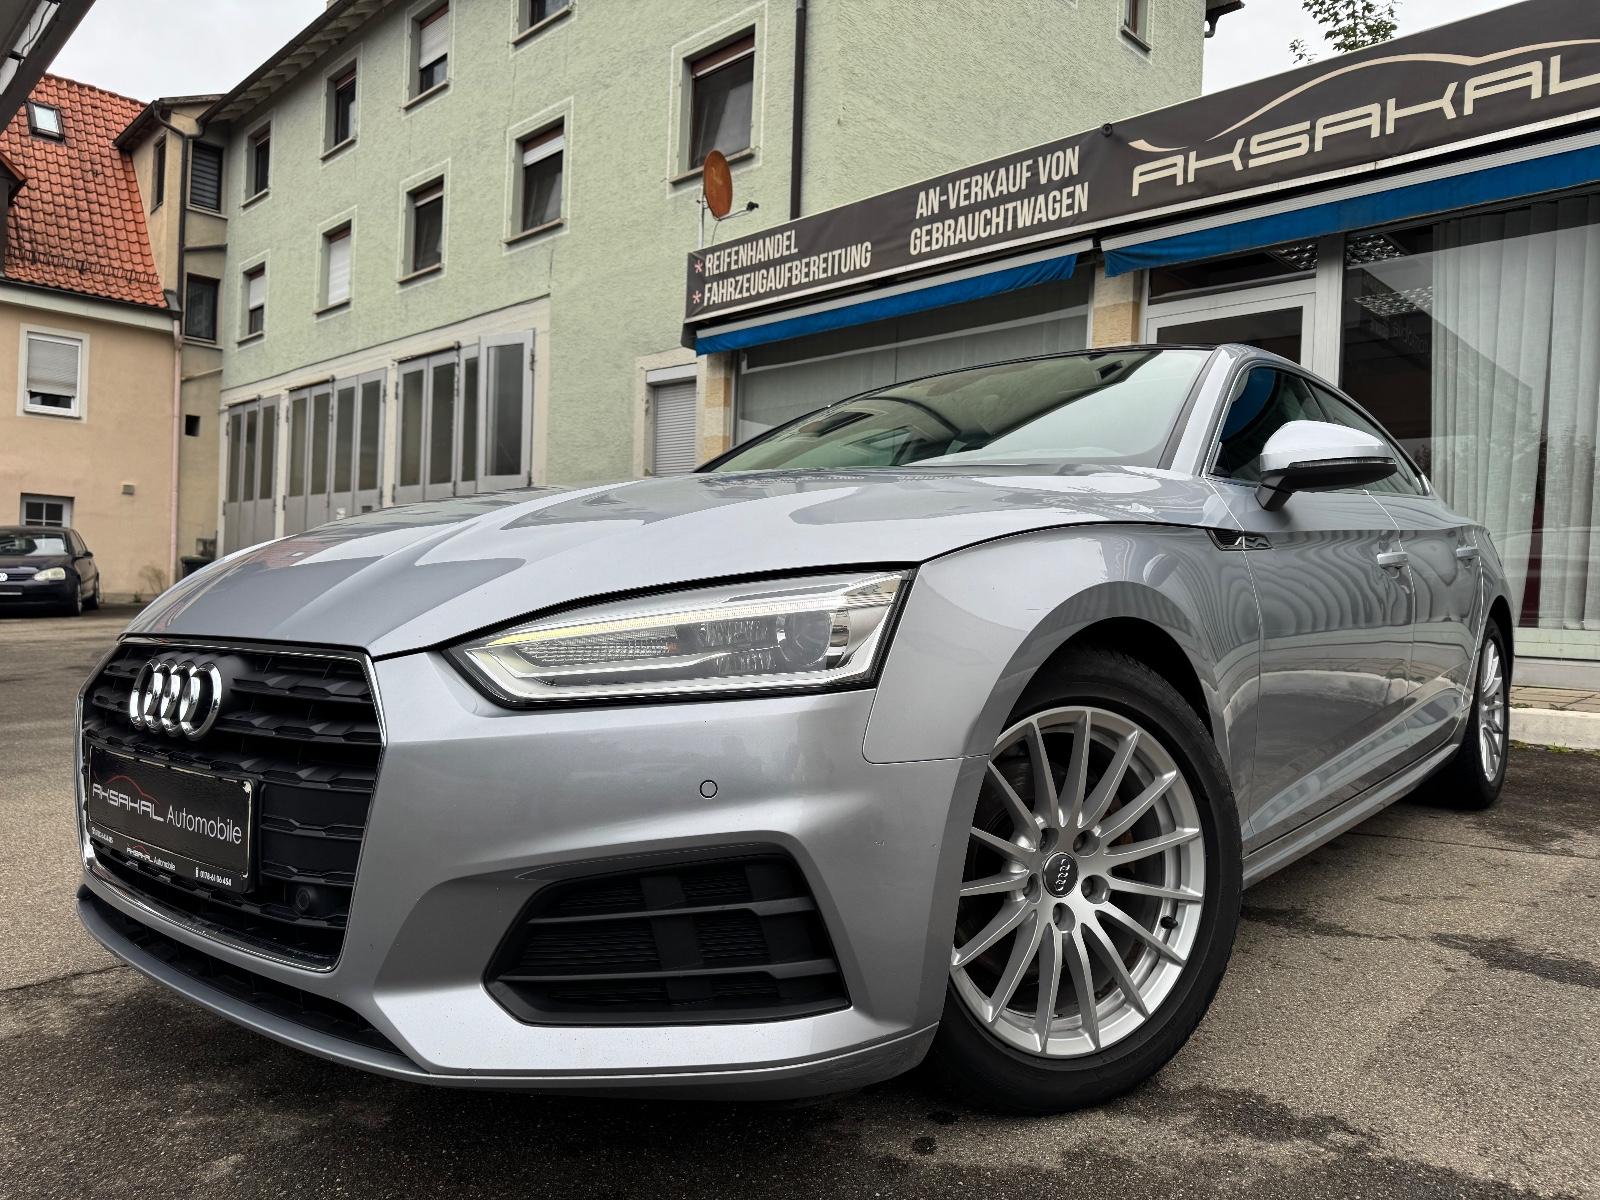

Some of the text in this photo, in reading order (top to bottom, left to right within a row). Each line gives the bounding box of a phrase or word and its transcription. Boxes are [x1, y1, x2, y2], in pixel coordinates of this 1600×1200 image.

[1132, 54, 1600, 197] AKSAKAL
[915, 145, 1080, 220] AN-VERKAUF VON
[705, 230, 798, 277] REIFENHANDEL
[909, 182, 1089, 256] GEBRAUCHTWAGEN
[704, 241, 872, 306] FAHRZEUGAUFBEREITUNG
[92, 783, 242, 845] AKSAKAL Automobile
